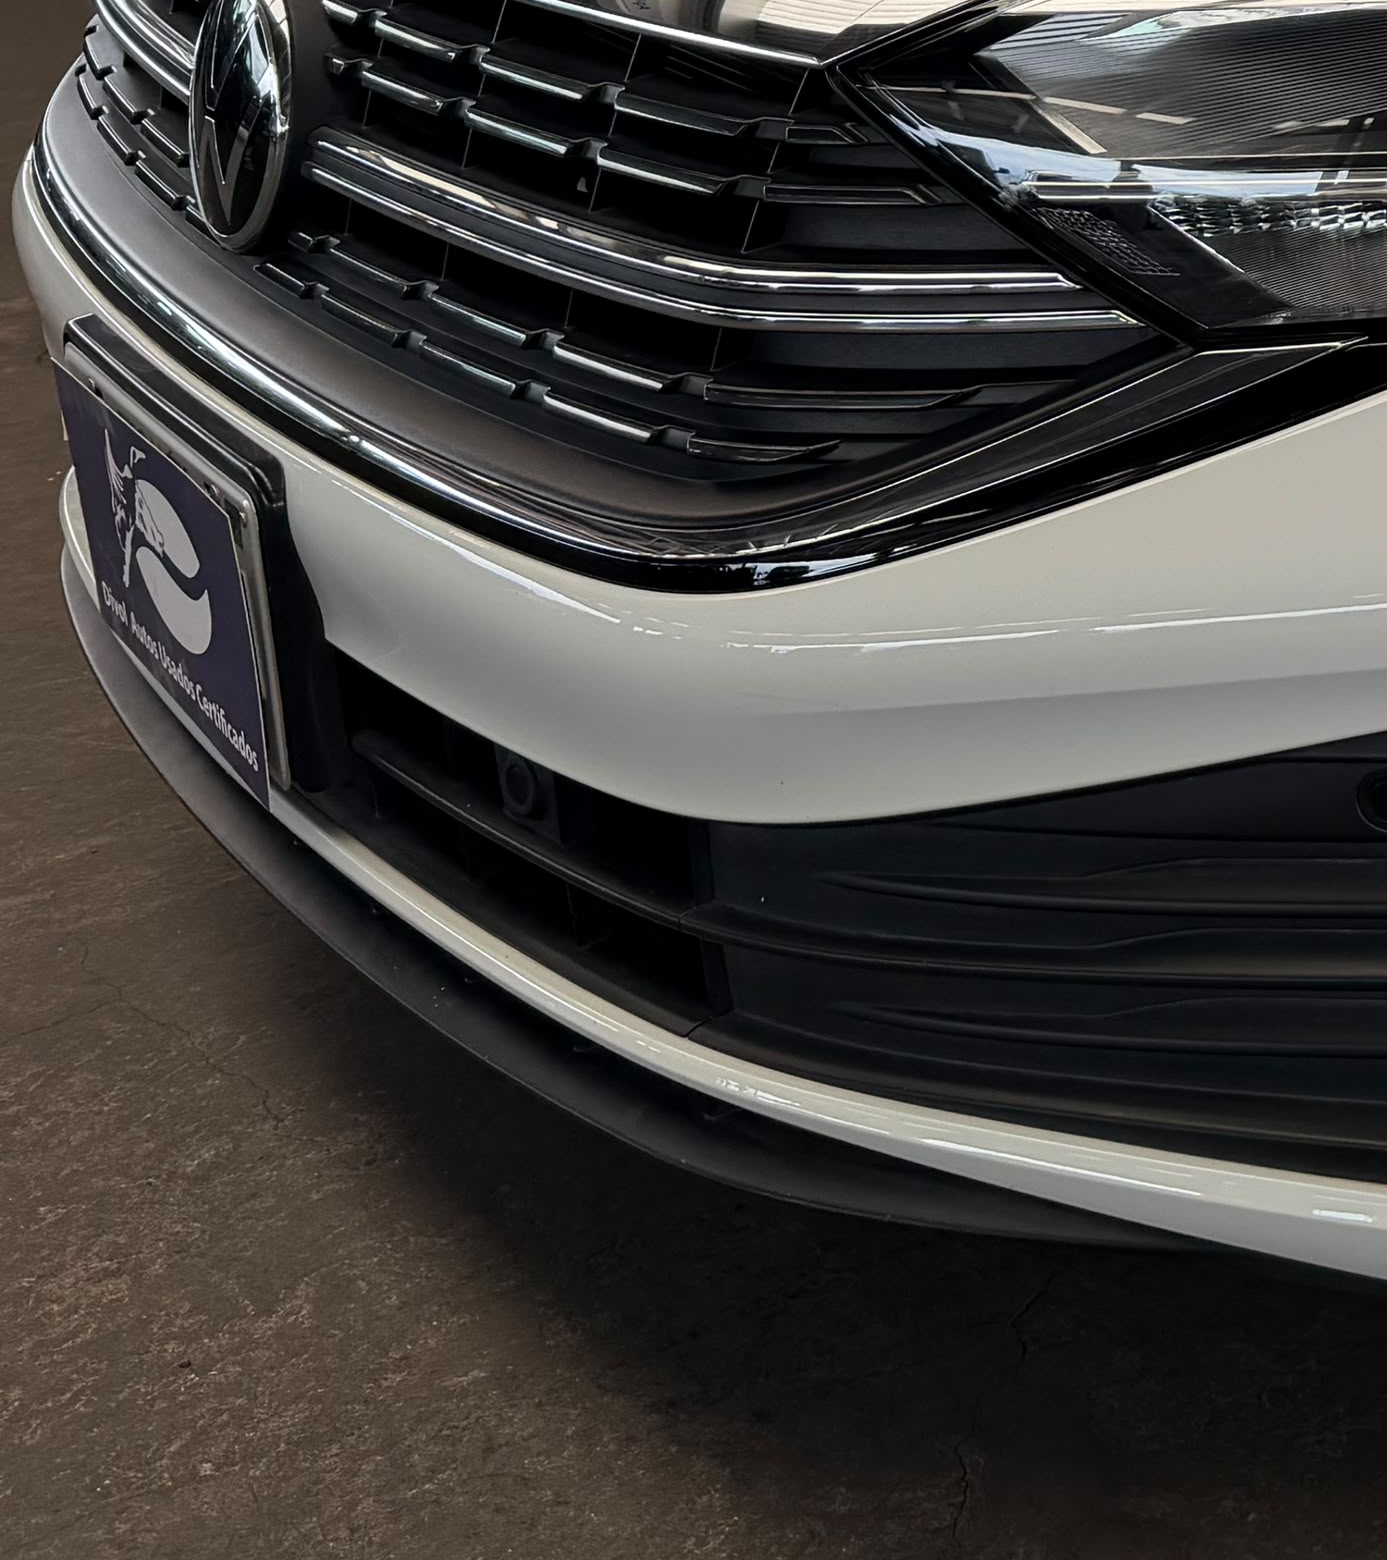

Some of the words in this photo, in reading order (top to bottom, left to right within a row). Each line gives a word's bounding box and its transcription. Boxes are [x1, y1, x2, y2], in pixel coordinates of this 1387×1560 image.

[101, 580, 129, 626] Divol
[130, 611, 159, 660] Autos
[158, 640, 196, 702] Usados
[195, 683, 259, 773] Certificados
